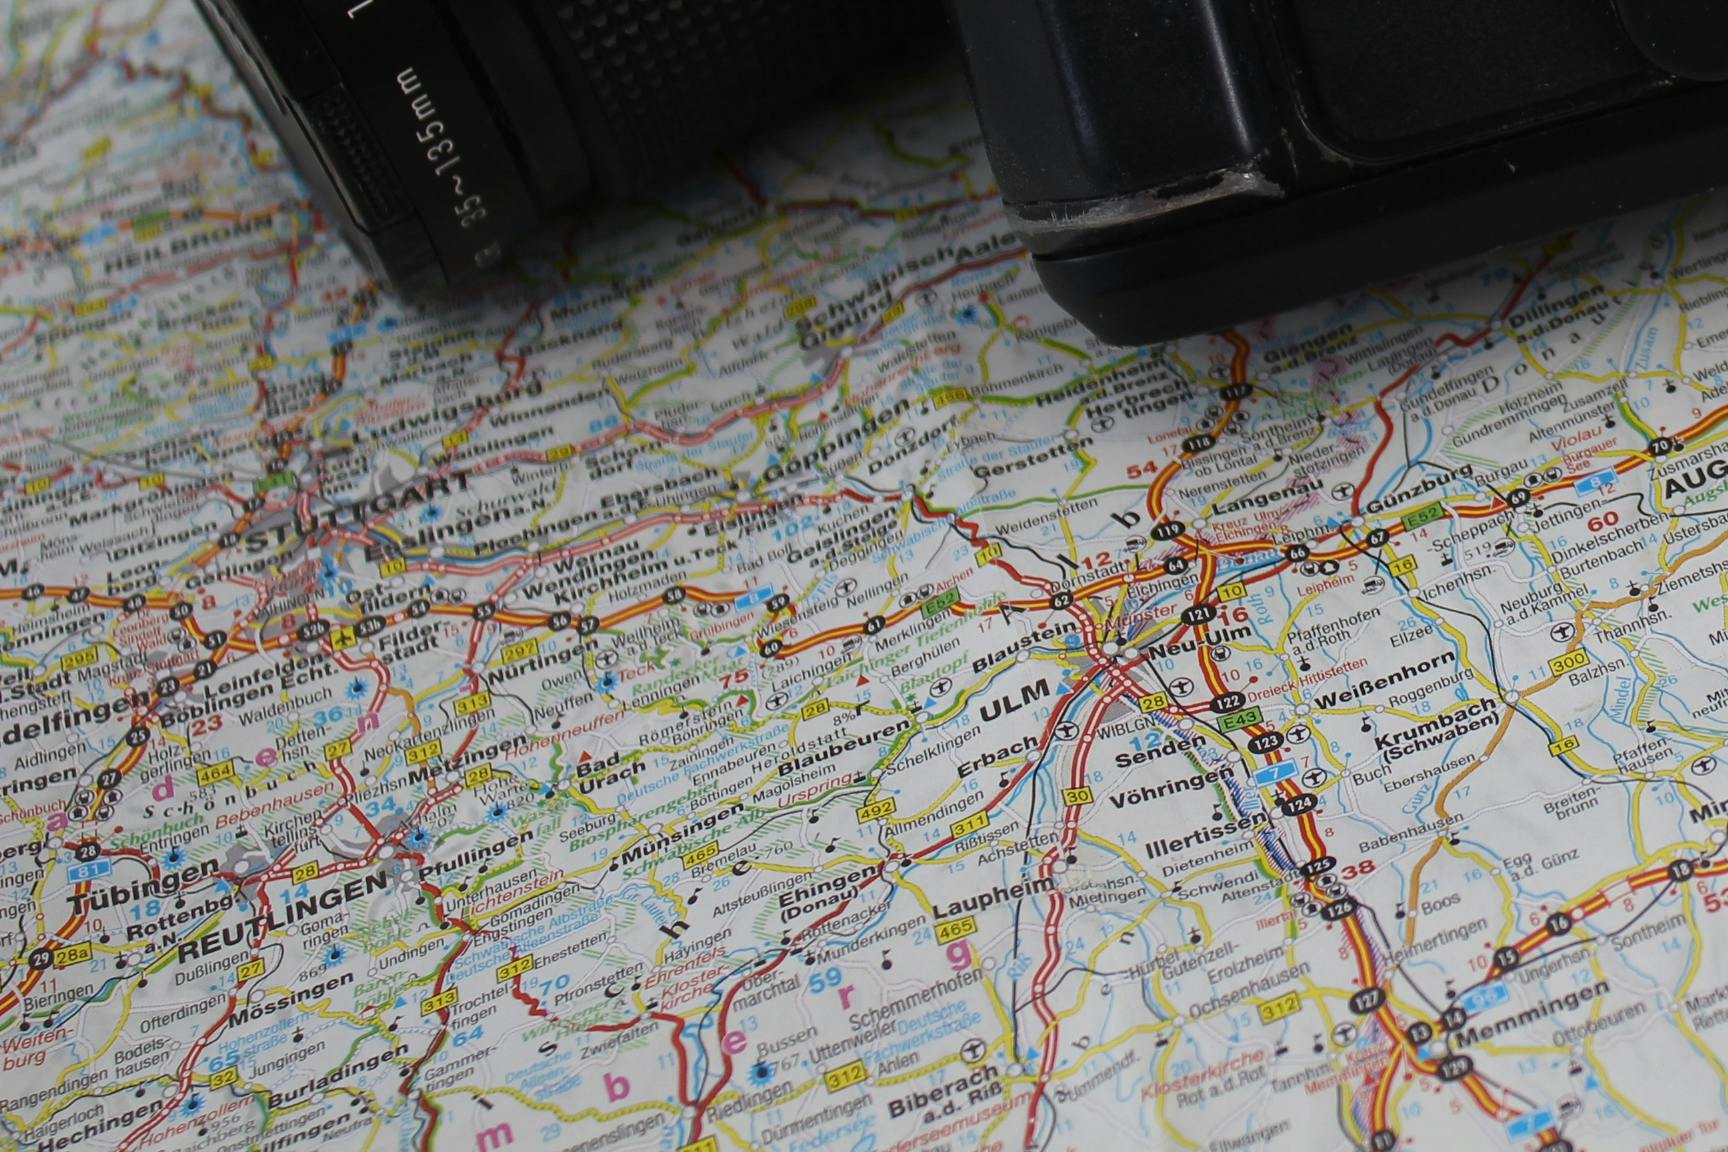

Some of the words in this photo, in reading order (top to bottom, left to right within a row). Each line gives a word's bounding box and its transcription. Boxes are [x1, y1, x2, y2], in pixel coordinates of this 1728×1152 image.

[396, 67, 487, 228] 35~135mm
[762, 398, 911, 484] Göppingen
[974, 436, 1093, 479] Gerstetten
[1366, 464, 1473, 515] Günzburg
[246, 474, 471, 555] STUTTGART
[474, 510, 599, 555] Plochingen
[996, 500, 1098, 535] Weidenstetten
[1405, 508, 1439, 526] E52
[186, 548, 294, 591] Gerlingen
[523, 549, 654, 599] Wendlingen
[1393, 560, 1414, 573] 16
[926, 594, 956, 614] E52
[1187, 608, 1210, 621] 121
[875, 611, 952, 651] Merklingen
[1150, 624, 1252, 661] Neu-Ulm
[1287, 606, 1382, 645] Pfaffenhofen
[64, 652, 95, 667] 295
[488, 639, 599, 685] Nürtingen
[505, 643, 535, 660] 297
[891, 638, 960, 676] Berghülen
[972, 622, 1077, 673] Blaustein
[1554, 652, 1586, 673] 300
[204, 651, 325, 697] Leinfelden-
[281, 665, 338, 694] Echt.
[622, 675, 700, 711] Lenningen
[1315, 651, 1455, 709] Weißenhorn
[1389, 667, 1474, 707] Roggenburg
[160, 689, 277, 729] Böblingen
[239, 687, 332, 727] Waldenbuch
[458, 697, 488, 714] 313
[535, 692, 593, 720] Neuffen
[981, 679, 1050, 723] ULM
[1216, 694, 1240, 707] 122
[1223, 711, 1257, 728] E43
[1375, 699, 1496, 751] Krumbach
[1382, 711, 1499, 764] (Schwaben)
[408, 734, 527, 788] Metzingen
[576, 753, 620, 778] Bad
[779, 719, 910, 777] Blaubeuren
[957, 736, 1038, 779] Erbach
[1116, 736, 1207, 770] Senden
[201, 766, 230, 782] 464
[579, 762, 646, 793] Urach
[1109, 767, 1236, 810] Vöhringen
[1353, 765, 1392, 785] Buch
[1384, 754, 1476, 793] Ebershausen
[216, 781, 334, 831] Bebenhausen
[861, 802, 892, 819] 492
[884, 790, 984, 837] Allmendingen
[1068, 790, 1089, 802] 30
[140, 824, 210, 854] Entringen
[559, 814, 616, 843] Seeburg
[621, 803, 744, 865] Münsingen
[954, 815, 985, 833] 311
[1145, 812, 1268, 860] Illertissen
[1359, 814, 1464, 853] Babenhausen
[419, 830, 535, 881] Pfullingen
[686, 845, 716, 863] 465
[977, 831, 1060, 866] Achstetten
[68, 858, 220, 916] Tübingen
[295, 866, 315, 879] 28
[779, 864, 876, 910] Ehingen
[1342, 860, 1375, 879] 38
[933, 876, 1056, 918] Laupheim
[126, 893, 240, 942] Rottenbg.
[178, 872, 388, 963] REUTLINGEN
[474, 907, 553, 946] Engstingen
[940, 920, 973, 938] 465
[57, 948, 88, 963] 28a
[534, 931, 608, 969] Ehestetten
[664, 927, 732, 963] Hayingen
[817, 914, 926, 965] Munderkingen
[175, 951, 250, 986] Dußlingen
[240, 963, 262, 978] 27
[500, 961, 531, 978] 312
[228, 972, 354, 1029] Mössingen
[849, 967, 983, 1031] Schemmerhofen
[1263, 999, 1296, 1018] 312
[1456, 979, 1610, 1049] Memmingen
[250, 1039, 326, 1079] Jungingen
[269, 1043, 408, 1109] Burladingen
[829, 1066, 862, 1084] 312
[214, 1072, 235, 1086] 32
[888, 1064, 999, 1118] Biberach
[38, 1100, 165, 1152] Hechingen
